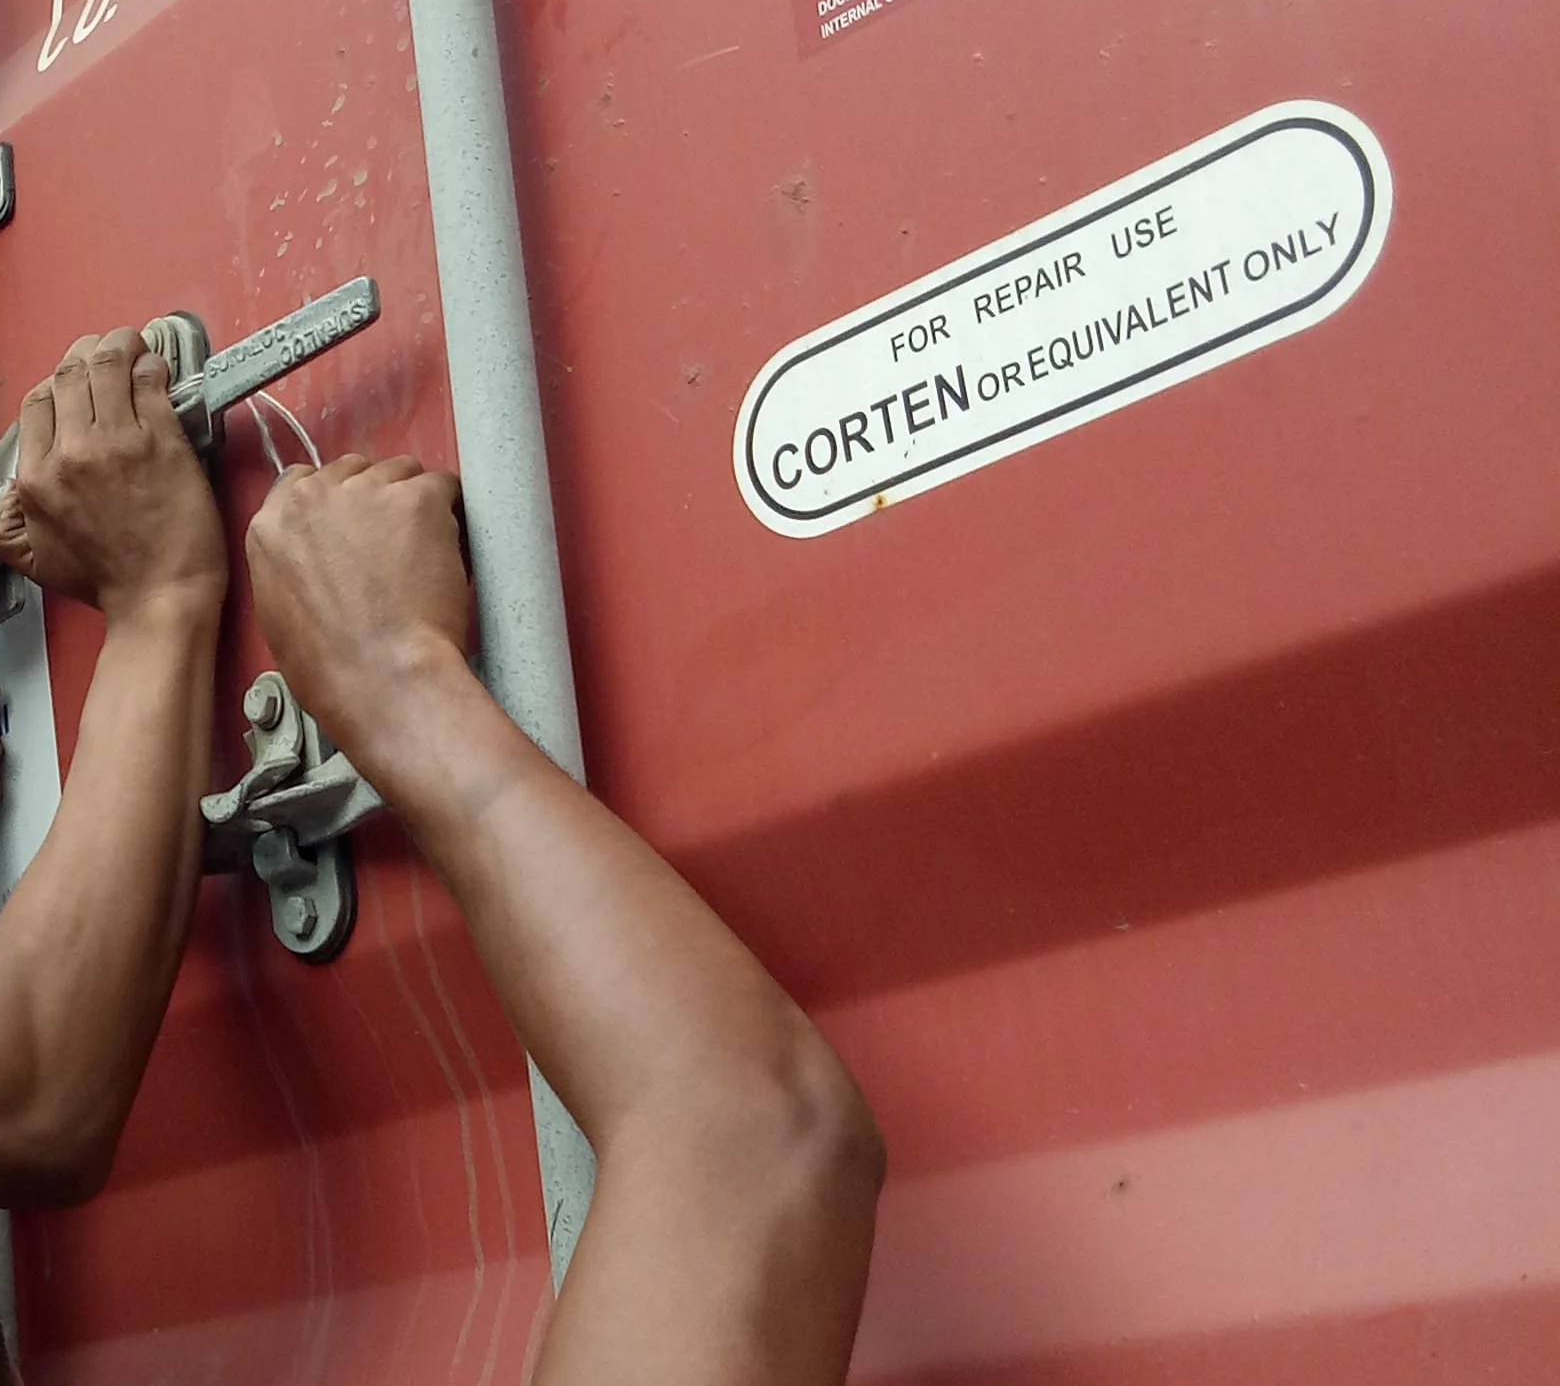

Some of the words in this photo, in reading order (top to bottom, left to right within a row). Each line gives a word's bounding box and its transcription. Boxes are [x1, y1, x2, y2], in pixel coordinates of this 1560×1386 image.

[772, 365, 972, 490] CORTEN
[977, 363, 1026, 403] OR
[1030, 262, 1230, 381] EQUIVALENT
[1243, 212, 1341, 282] ONLY
[891, 315, 951, 363] FOR
[974, 252, 1087, 324] REPAIR
[1112, 205, 1178, 259] USE
